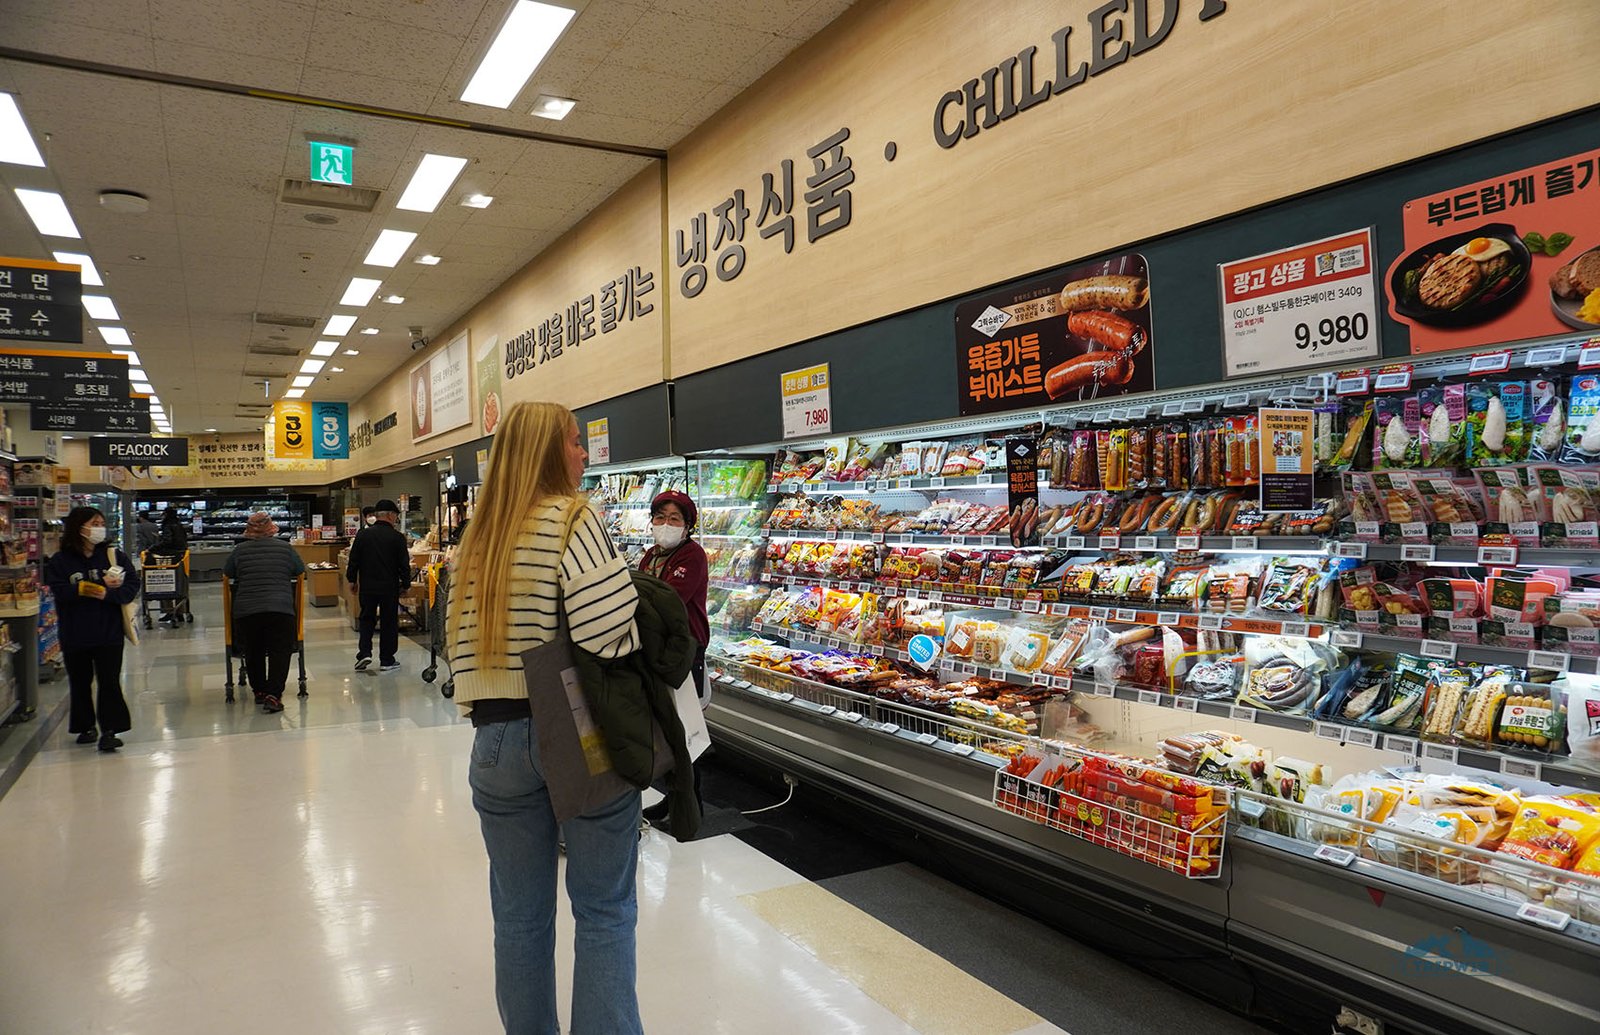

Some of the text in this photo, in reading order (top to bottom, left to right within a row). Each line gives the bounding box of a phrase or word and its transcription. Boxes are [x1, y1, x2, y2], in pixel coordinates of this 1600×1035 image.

[933, 0, 1181, 149] CHILLED
[675, 126, 856, 299] 냉장식품
[1427, 174, 1536, 228] 부드럽게
[1233, 267, 1266, 295] 광고
[1270, 257, 1307, 287] 상품
[1338, 285, 1363, 299] 340g
[505, 265, 655, 380] 생생한 맛을 바로 즐기는
[1295, 312, 1369, 352] 9,980
[967, 332, 1041, 373] 육즙가득
[74, 383, 110, 396] 통조림
[968, 364, 1044, 403] 부어스트
[48, 415, 76, 425] 시리얼
[805, 408, 829, 427] 7,980
[109, 443, 169, 456] PEACOCK
